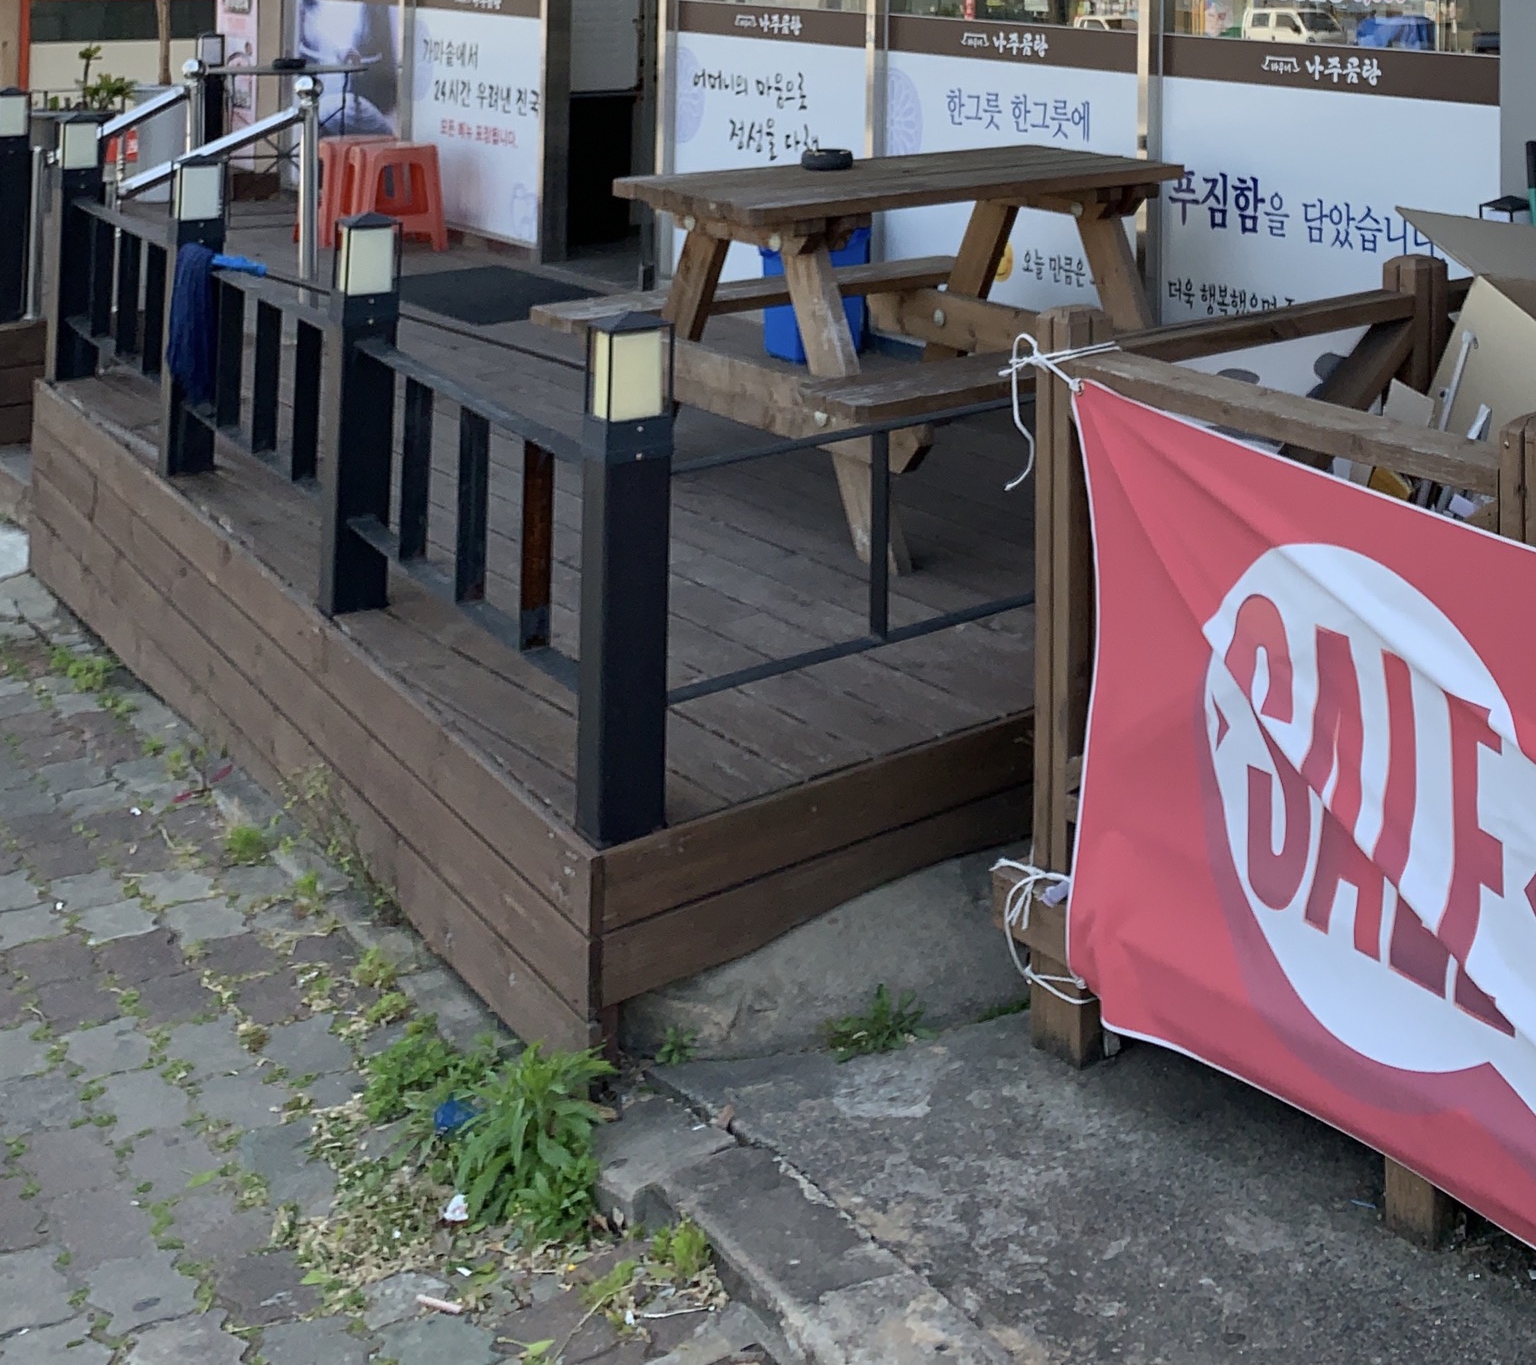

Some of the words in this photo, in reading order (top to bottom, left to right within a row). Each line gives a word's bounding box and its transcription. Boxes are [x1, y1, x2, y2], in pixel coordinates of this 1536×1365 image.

[423, 38, 478, 70] 가마솥에서
[1305, 55, 1382, 86] 나주곰탕
[477, 82, 511, 114] 우려낸
[516, 88, 540, 118] 진국
[693, 69, 748, 95] 어머니의
[756, 72, 807, 110] 마음으로
[946, 88, 1002, 131] 한그릇
[1010, 93, 1091, 142] 한그릇에
[729, 118, 777, 161] 정성을
[1169, 170, 1289, 237] 푸짐함을
[1022, 248, 1045, 280] 오늘
[1049, 255, 1086, 288] 만큼은
[1168, 277, 1195, 310] 더욱
[1225, 594, 1516, 1038] SALE
